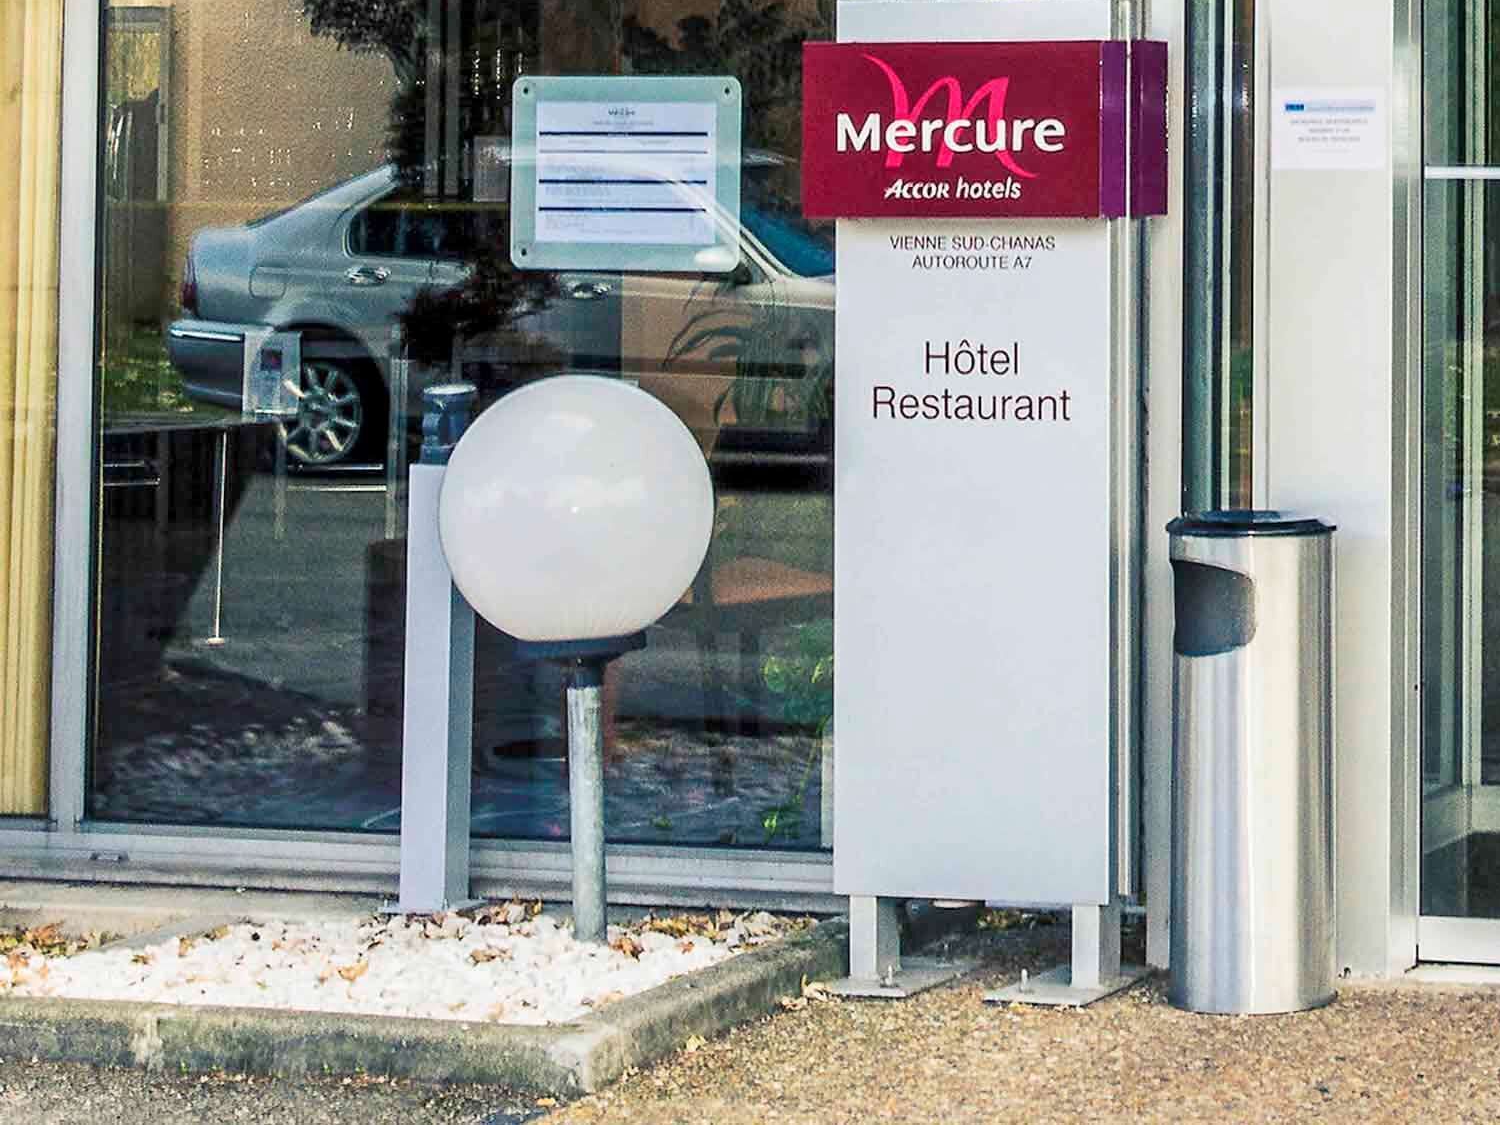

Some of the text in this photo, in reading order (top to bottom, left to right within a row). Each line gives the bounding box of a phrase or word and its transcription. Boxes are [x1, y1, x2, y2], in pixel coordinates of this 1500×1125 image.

[835, 112, 1066, 153] Mercure
[955, 176, 1022, 199] hotels
[889, 235, 1056, 251] VIENNE SUD-CHANAS
[912, 255, 1032, 269] AUTOROUTE A7
[925, 339, 1018, 375] Hôtel
[872, 386, 1071, 421] Restaurant
